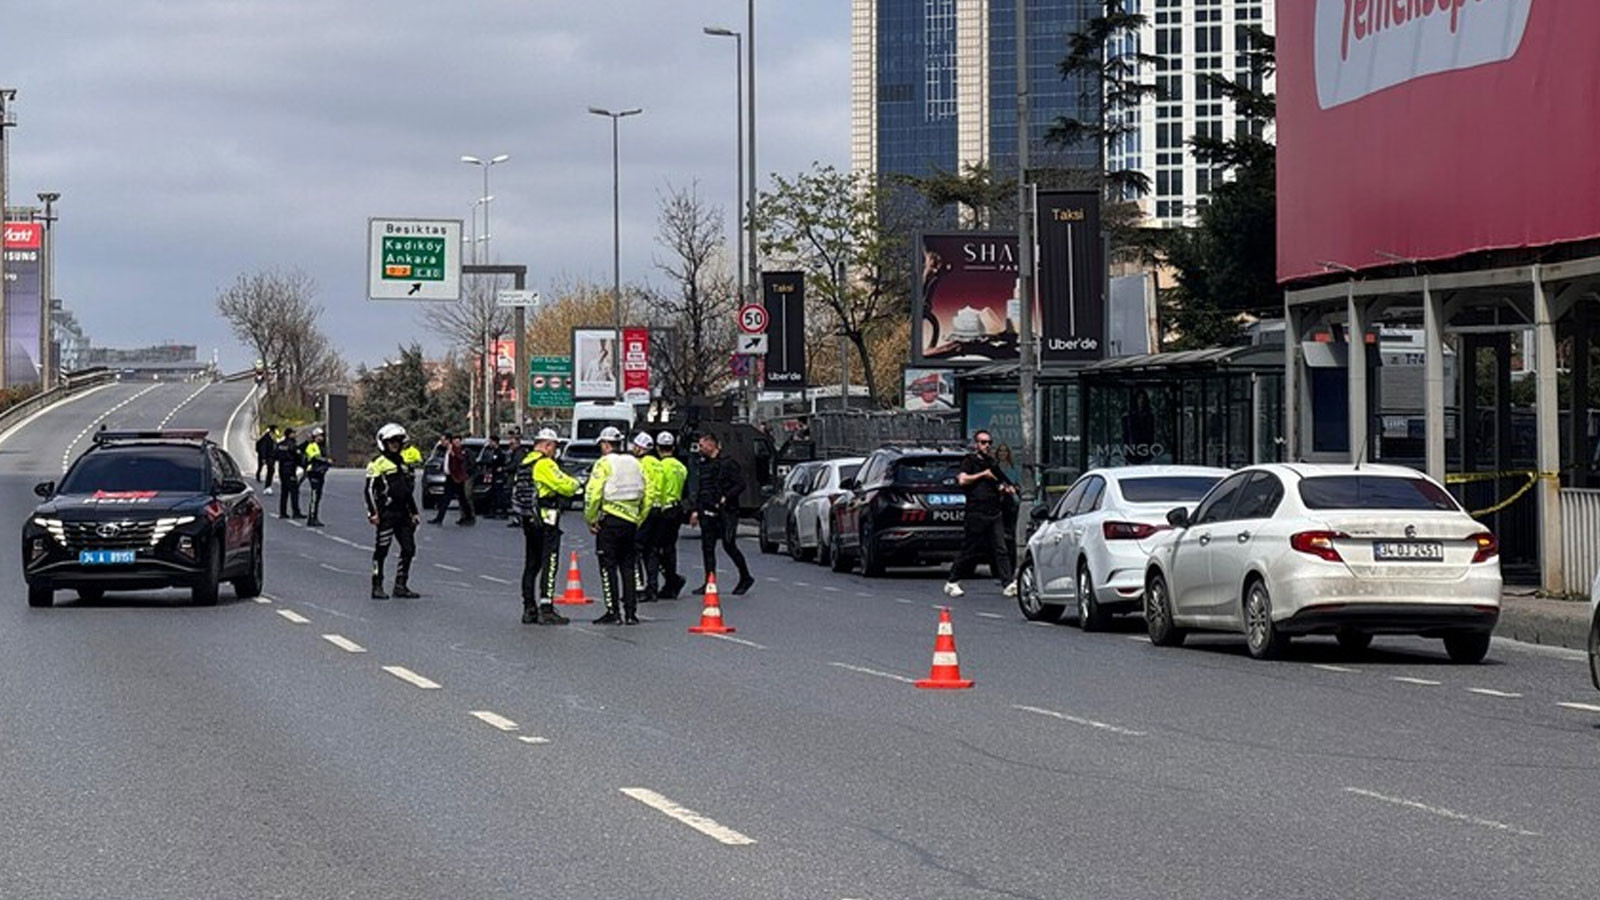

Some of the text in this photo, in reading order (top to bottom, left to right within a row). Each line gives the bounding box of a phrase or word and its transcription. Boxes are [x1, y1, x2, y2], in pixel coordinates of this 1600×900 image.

[1051, 208, 1084, 220] Taksi
[386, 253, 437, 264] Ankara
[963, 243, 1019, 262] SHA
[772, 284, 795, 293] Taksi
[745, 312, 762, 326] 50
[1049, 338, 1097, 350] Uber'de
[768, 372, 802, 381] Uber'de
[1096, 443, 1164, 457] MANGO
[1382, 544, 1393, 556] 34
